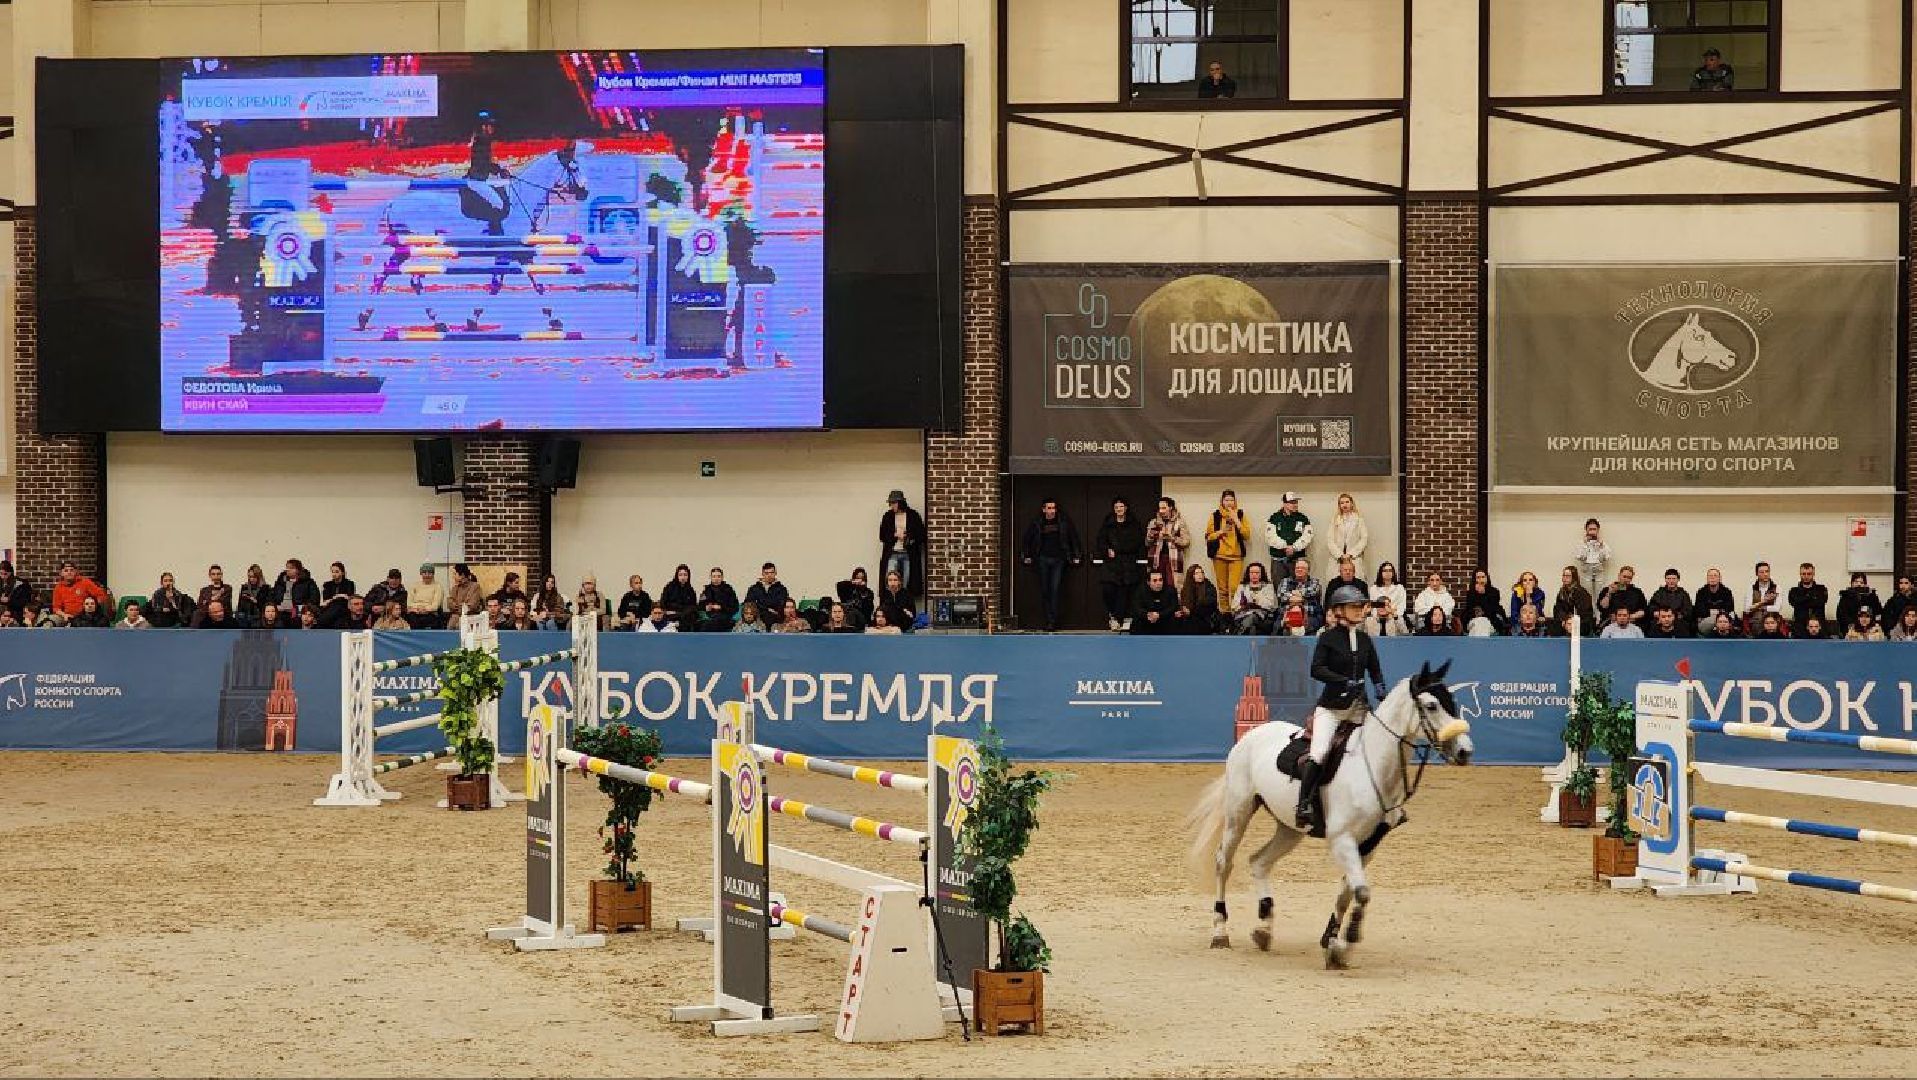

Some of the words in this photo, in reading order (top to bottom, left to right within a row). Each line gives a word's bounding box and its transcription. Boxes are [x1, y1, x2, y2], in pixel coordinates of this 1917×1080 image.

[599, 76, 633, 89] Кубок
[719, 74, 748, 86] MINI
[749, 73, 802, 85] MASTERS
[187, 95, 233, 109] КУБОК
[236, 95, 293, 109] КРЕМЛЯ
[1615, 280, 1773, 325] ТЕХНОЛОГИЯ
[1169, 321, 1353, 355] КОСМЕТИКА
[1056, 335, 1131, 361] COSMO
[1056, 364, 1131, 399] DEUS
[1168, 368, 1221, 398] ДЛЯ
[1229, 362, 1353, 398] ЛОШАДЕЙ
[1636, 388, 1753, 419] СПОРТА
[1283, 423, 1317, 433] КУПИТЬ
[1064, 440, 1143, 453] COSMO-DEUS.RU
[1282, 437, 1294, 447] НА
[1295, 437, 1318, 447] OZON
[1547, 434, 1672, 451] КРУПНЕЙШАЯ
[1676, 436, 1723, 451] СЕТЬ
[1727, 436, 1840, 451] МАГАЗИНОВ
[1590, 457, 1628, 473] ДЛЯ
[1632, 456, 1717, 471] КОННОГО
[1722, 456, 1796, 471] СПОРТА
[36, 674, 96, 684] ФЕДЕРАЦИЯ
[1076, 680, 1156, 694] MAXIMA
[35, 686, 81, 696] КОННОГО
[83, 686, 122, 696] СПОРТА
[1490, 682, 1557, 693] ФЕДЕРАЦИЯ
[34, 698, 74, 709] РОССИИ
[741, 671, 999, 722] КРЕМЛЯ
[1490, 695, 1542, 706] КОННОГО
[1640, 694, 1678, 709] MAXIMA
[1691, 679, 1879, 731] УБОК
[1490, 709, 1534, 719] РОССИИ
[939, 866, 977, 887] MAXIM
[723, 875, 761, 901] MAXIMA
[842, 897, 874, 1034] СТАРТ
